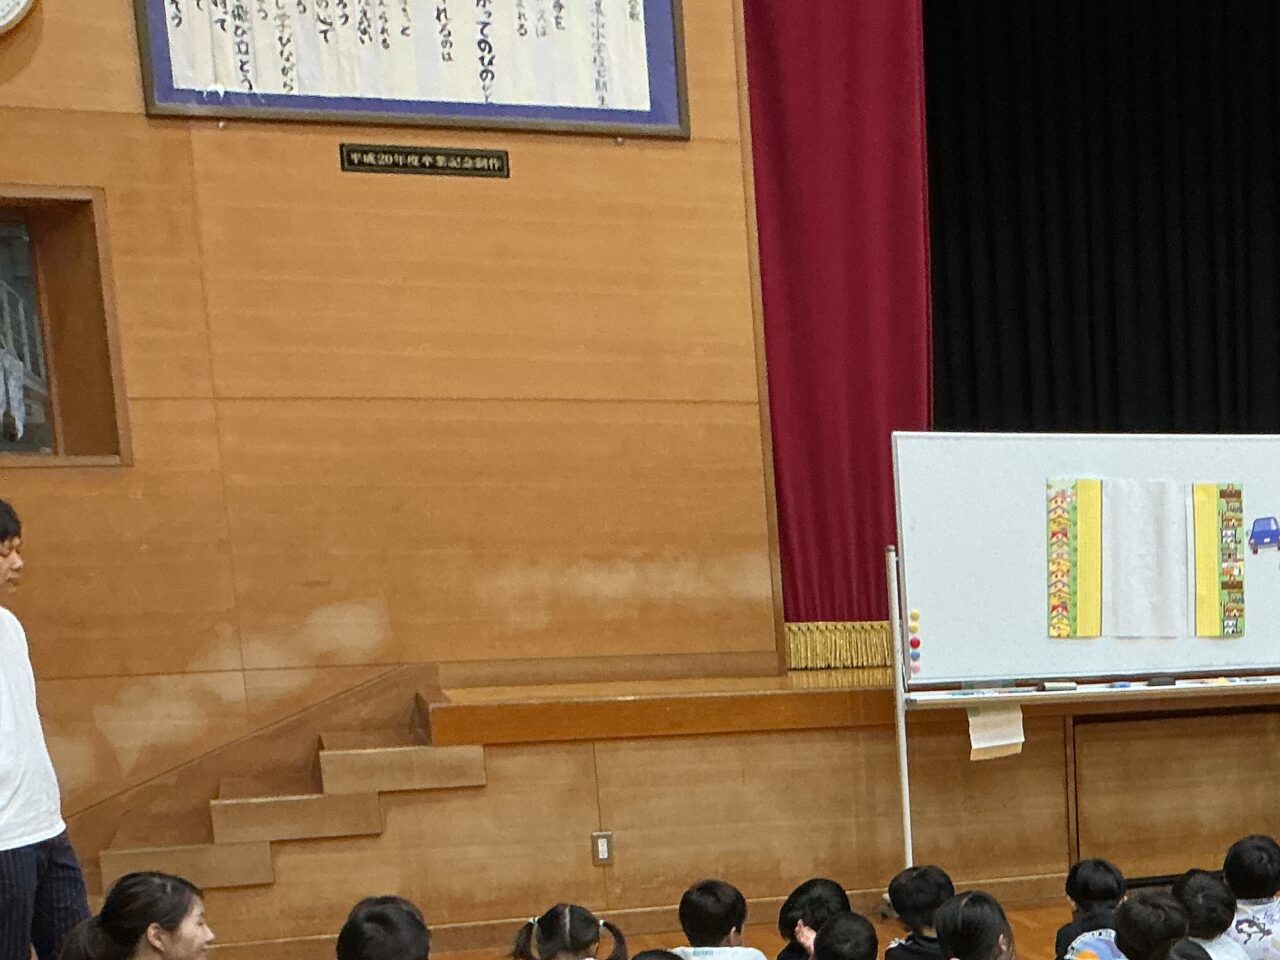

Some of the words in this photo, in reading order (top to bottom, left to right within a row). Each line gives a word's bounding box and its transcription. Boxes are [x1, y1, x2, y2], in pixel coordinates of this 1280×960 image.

[350, 151, 499, 170] 平成20年度卒業記念制作
